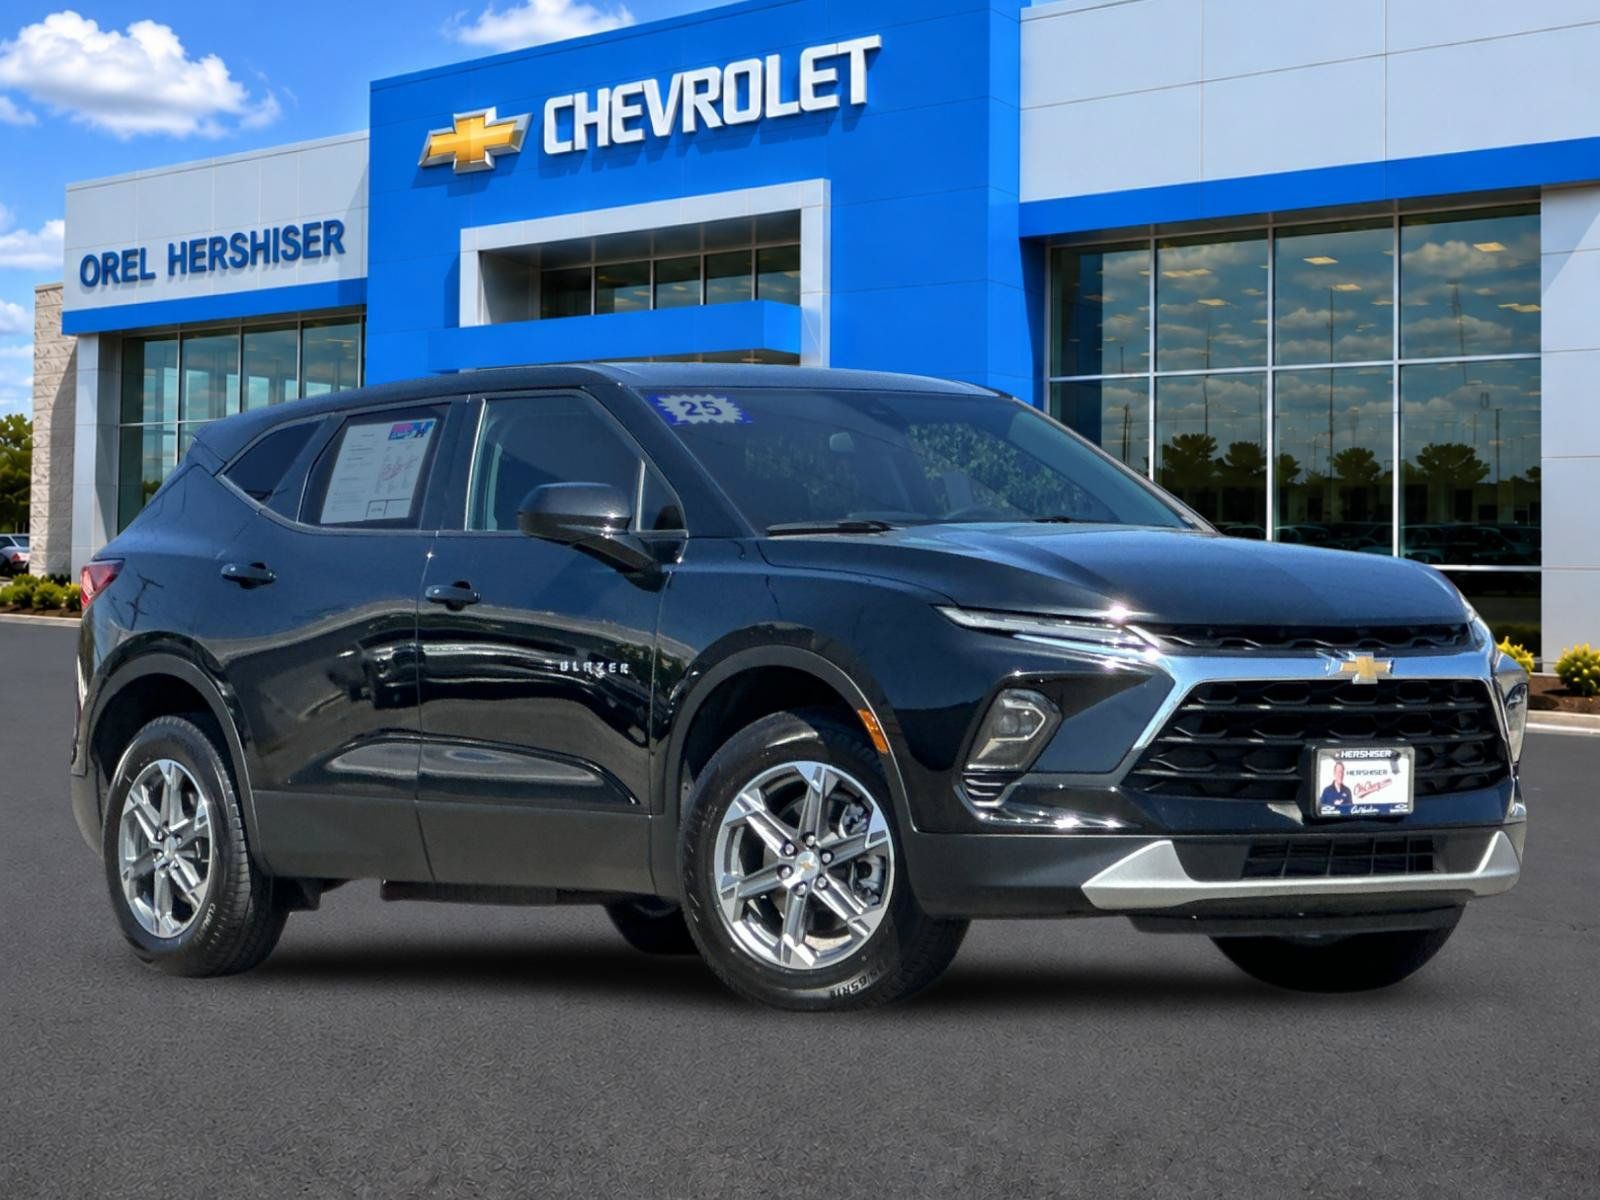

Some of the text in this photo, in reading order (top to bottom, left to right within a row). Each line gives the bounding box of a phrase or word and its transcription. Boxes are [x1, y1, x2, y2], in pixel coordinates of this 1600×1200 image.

[544, 34, 882, 155] CHEVROLET
[80, 219, 346, 288] OREL HERSHISER
[679, 400, 723, 416] 25
[559, 660, 630, 675] BLAZER
[1340, 749, 1392, 759] HERSHISER
